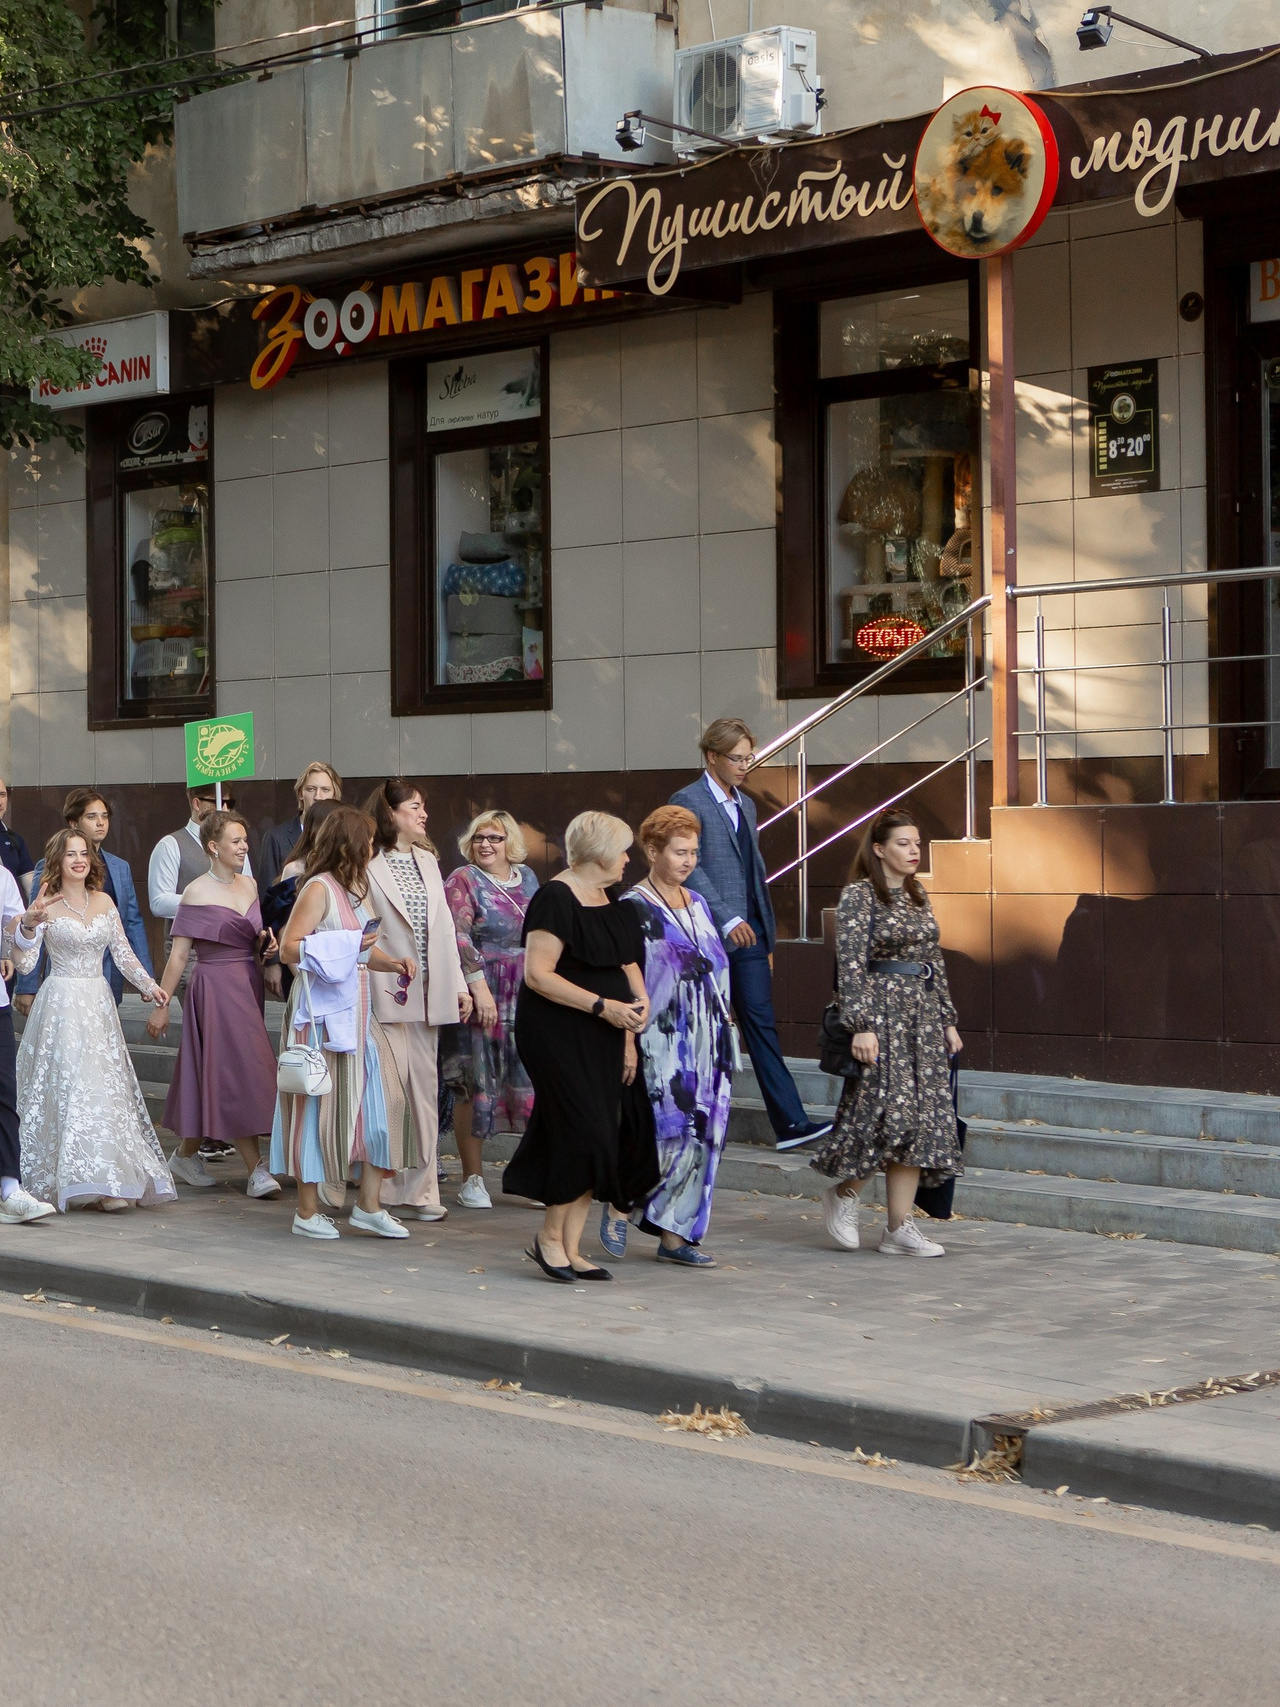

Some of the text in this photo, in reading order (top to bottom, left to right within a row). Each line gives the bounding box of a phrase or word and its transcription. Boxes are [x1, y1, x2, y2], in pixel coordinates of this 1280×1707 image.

[748, 50, 775, 66] oasis
[578, 152, 914, 296] Пушистый
[250, 252, 631, 390] ЗООМАГАЗИ
[95, 354, 151, 387] CANIN
[440, 374, 477, 399] Sheba
[857, 629, 924, 646] ОТКРЫТО
[193, 757, 237, 776] ГИМНАЗИЯ
